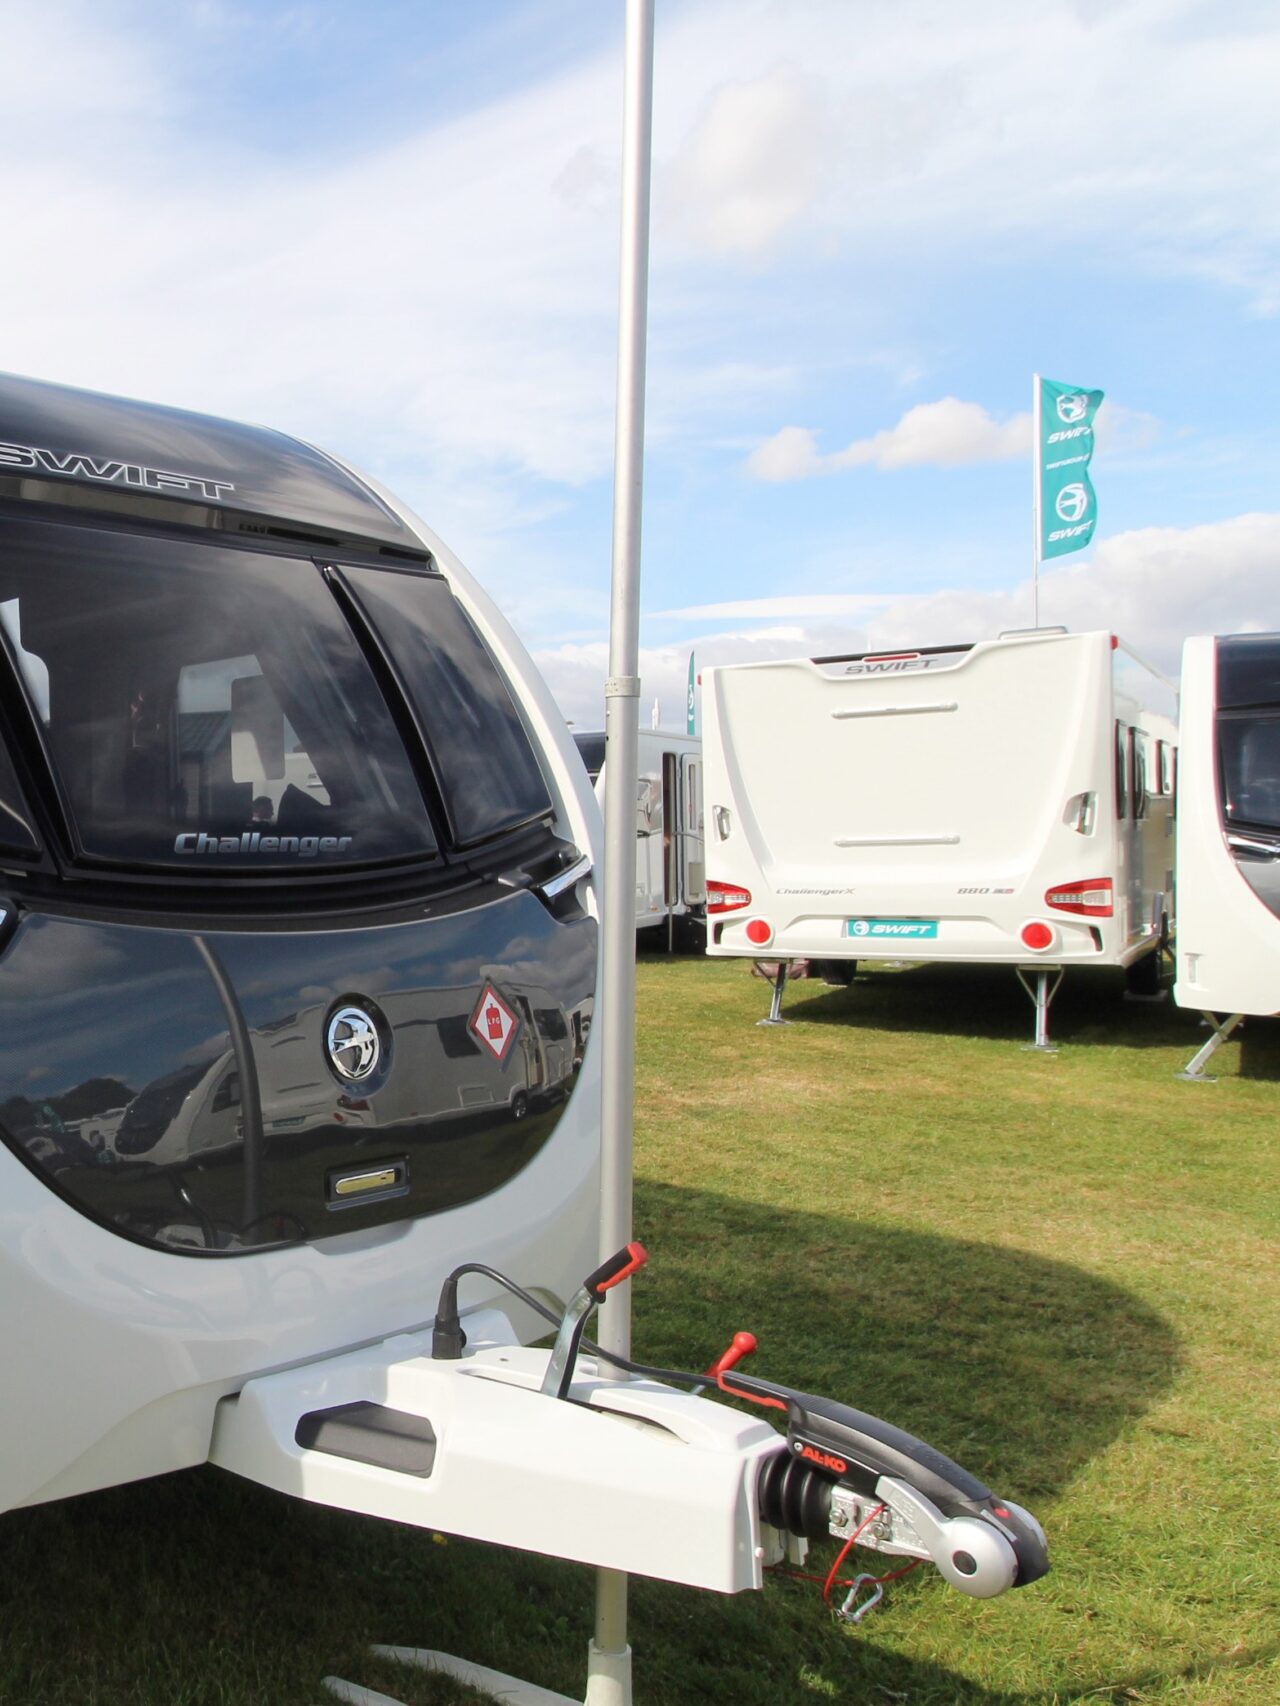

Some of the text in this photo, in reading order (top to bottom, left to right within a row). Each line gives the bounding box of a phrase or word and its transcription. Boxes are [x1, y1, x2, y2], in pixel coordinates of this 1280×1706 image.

[845, 659, 937, 674] SWIFT
[173, 832, 353, 857] Challenger
[871, 924, 931, 935] SWIFT
